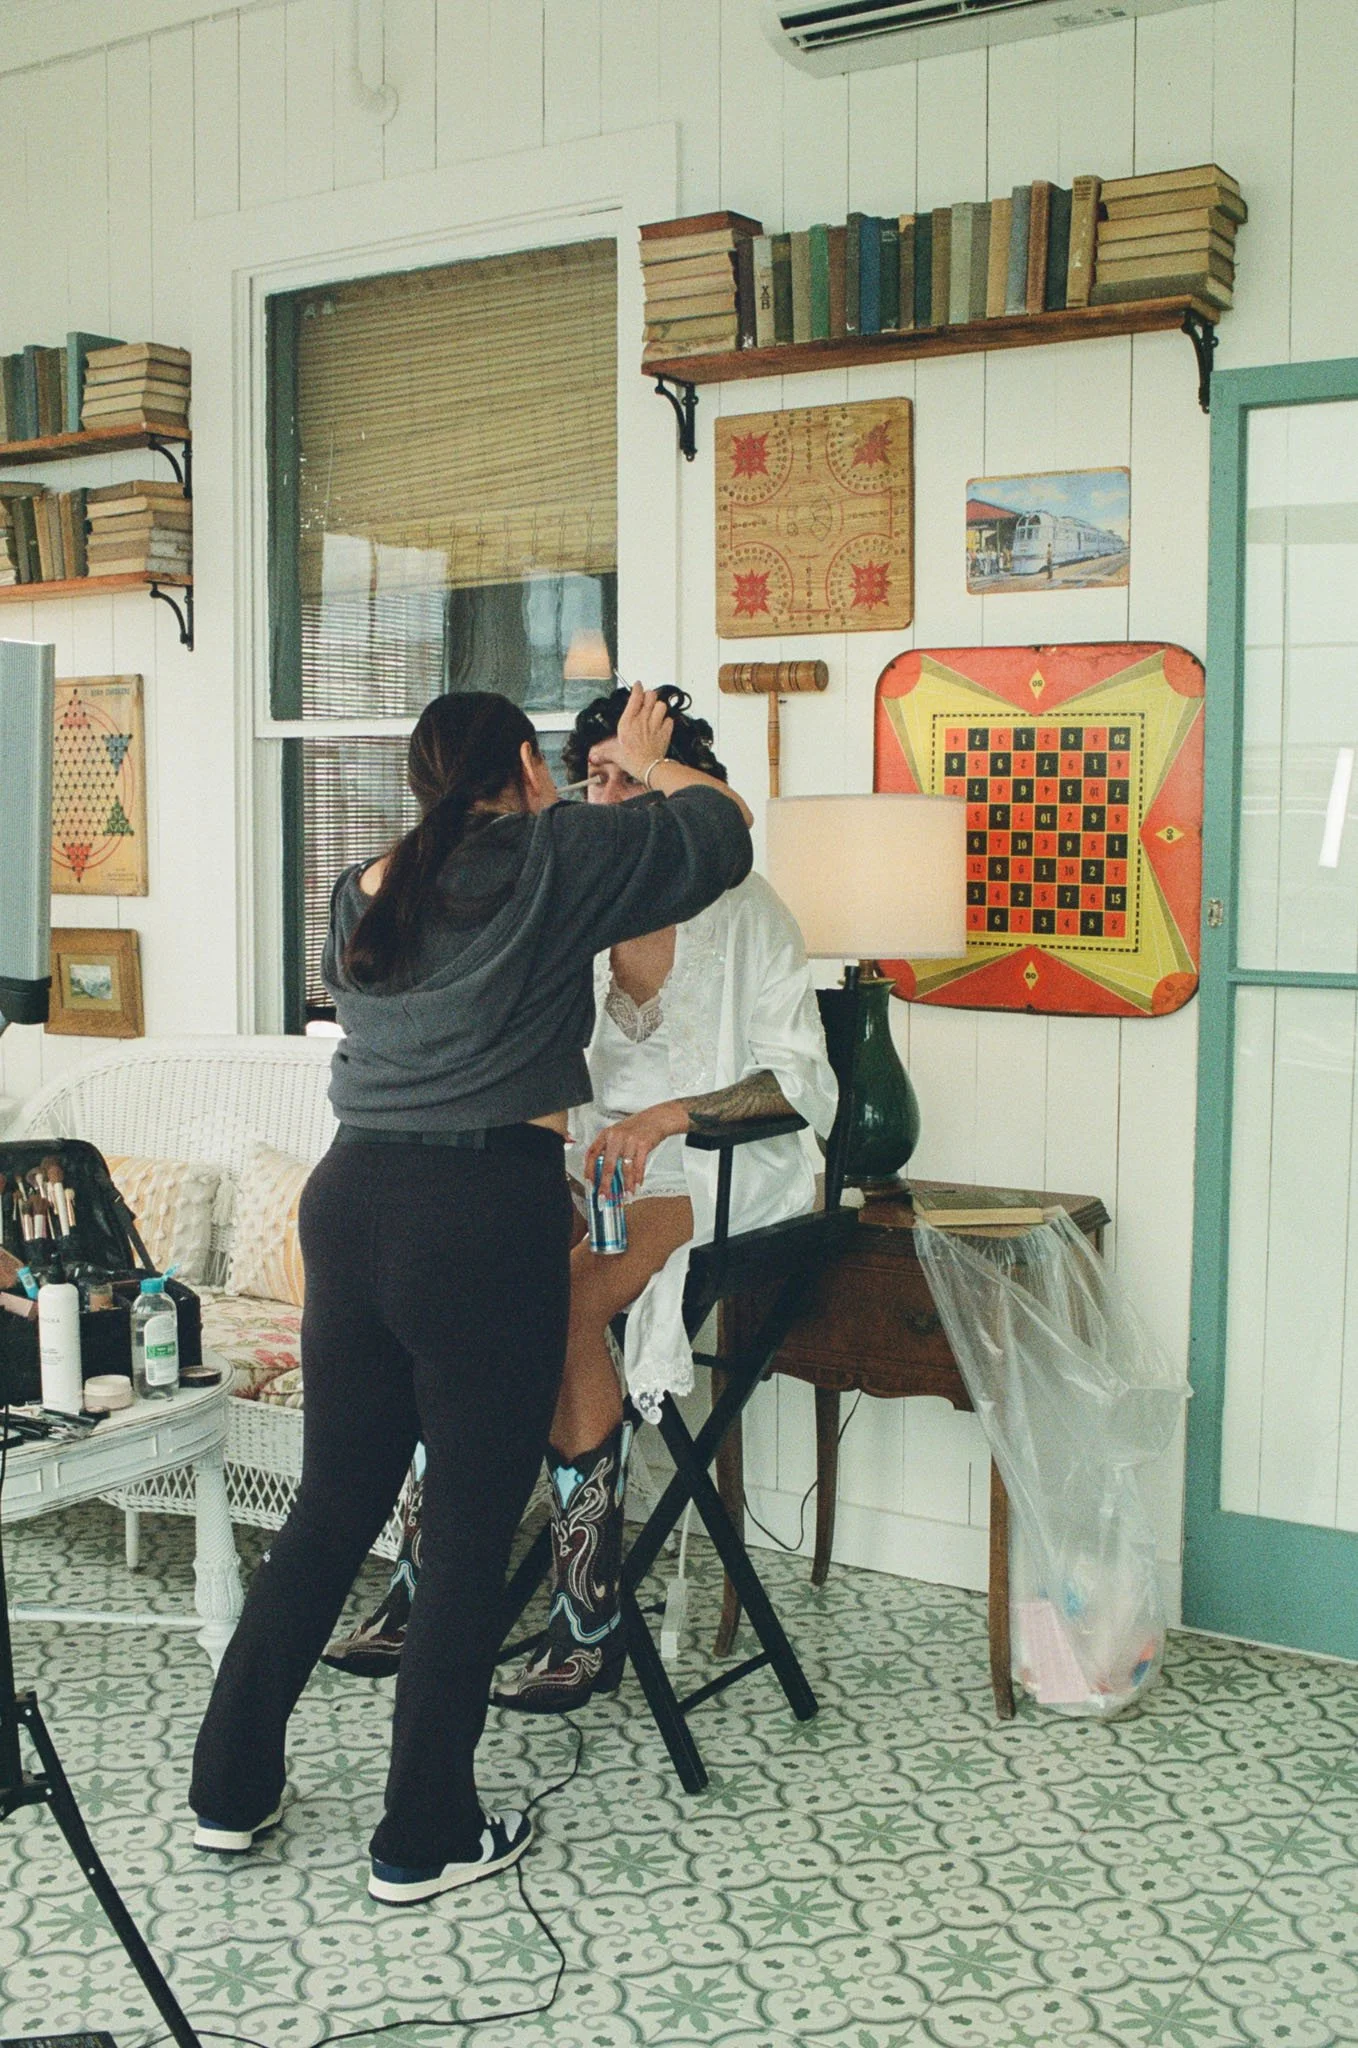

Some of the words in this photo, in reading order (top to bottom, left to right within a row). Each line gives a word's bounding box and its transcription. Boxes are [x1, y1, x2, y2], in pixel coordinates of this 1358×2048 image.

[1113, 733, 1126, 745] 20
[1040, 812, 1051, 824] 10
[1017, 839, 1028, 850] 10
[1111, 893, 1121, 905] 15
